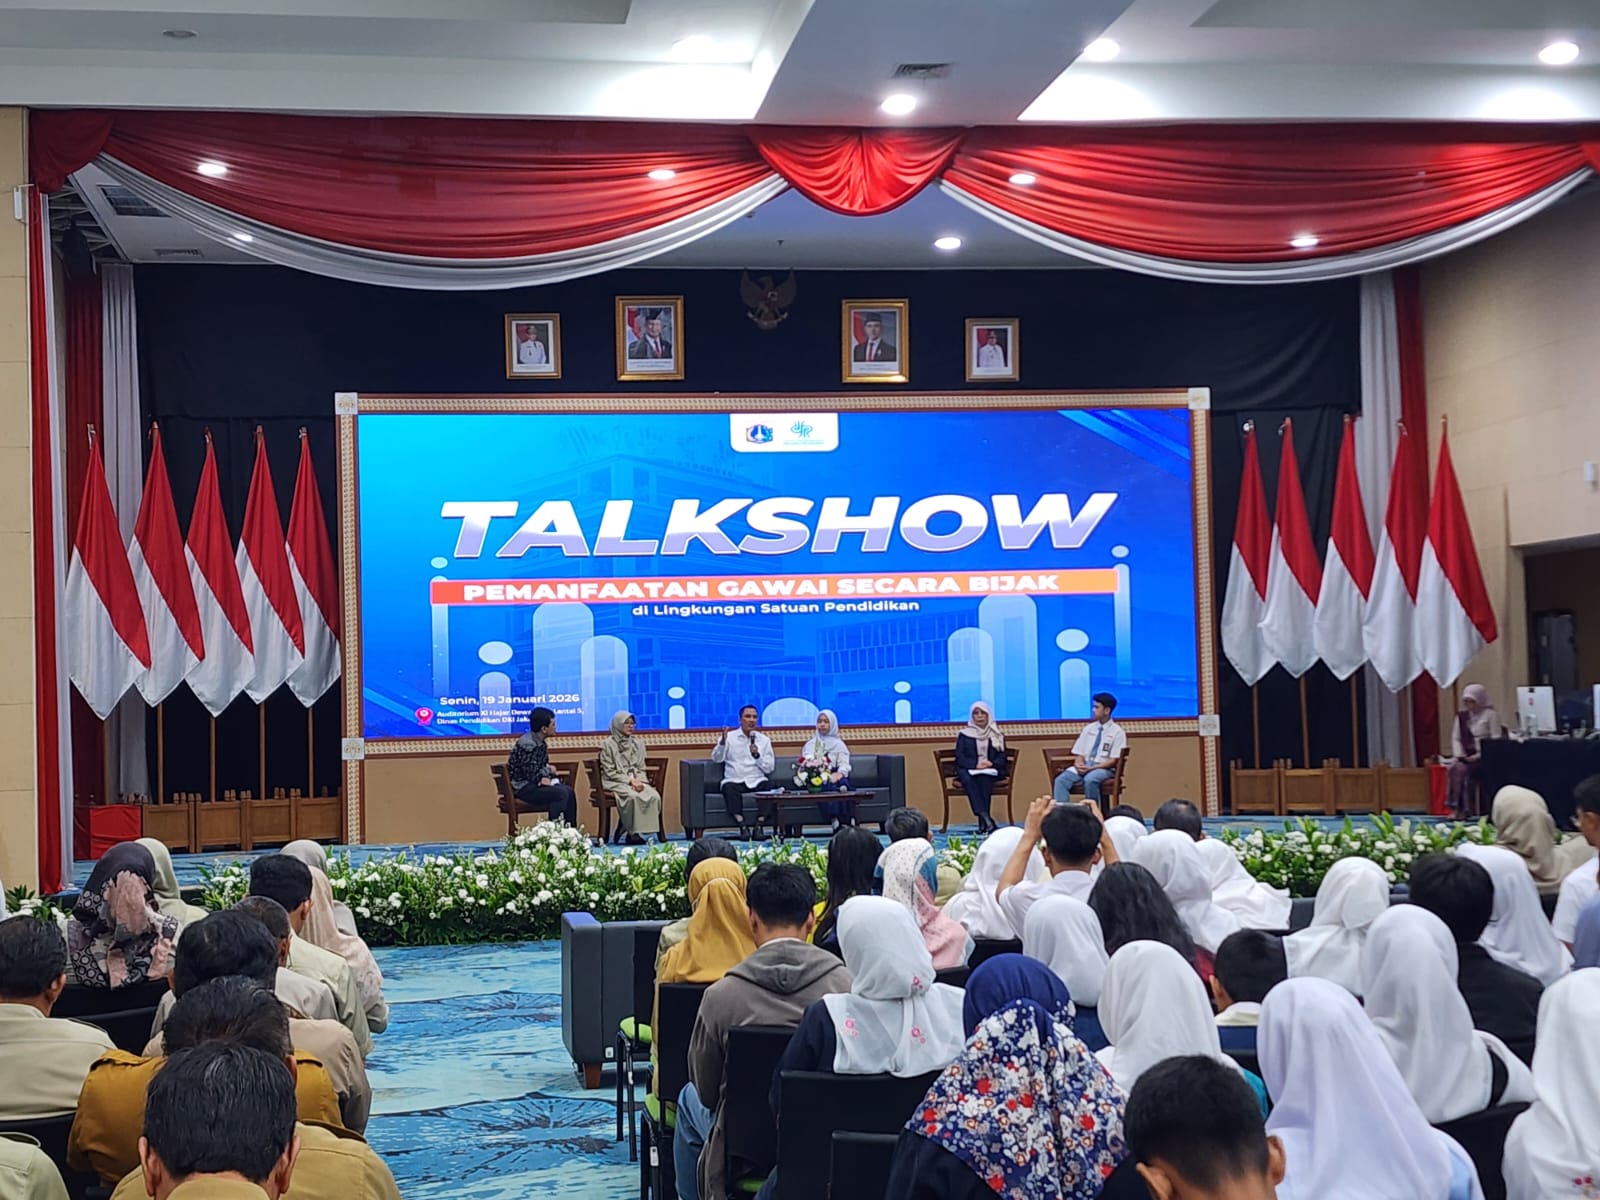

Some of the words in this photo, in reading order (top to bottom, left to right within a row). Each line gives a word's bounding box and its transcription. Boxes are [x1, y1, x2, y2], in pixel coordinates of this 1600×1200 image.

[440, 492, 1118, 558] TALKSHOW
[463, 580, 709, 602] PEMANFAATAN
[718, 578, 828, 598] GAWAI
[836, 576, 961, 595] SECARA
[969, 574, 1060, 592] BIJAK
[632, 605, 648, 616] di
[654, 603, 756, 617] Lingkungan
[760, 602, 820, 614] Satuan
[824, 600, 920, 612] Pendidikan
[440, 695, 480, 706] Senin,
[482, 695, 496, 704] 19
[498, 693, 546, 705] Januari
[548, 694, 580, 703] 2026
[436, 710, 480, 718] Auditorium
[436, 717, 458, 725] Dinas
[459, 716, 501, 724] Pendidikan
